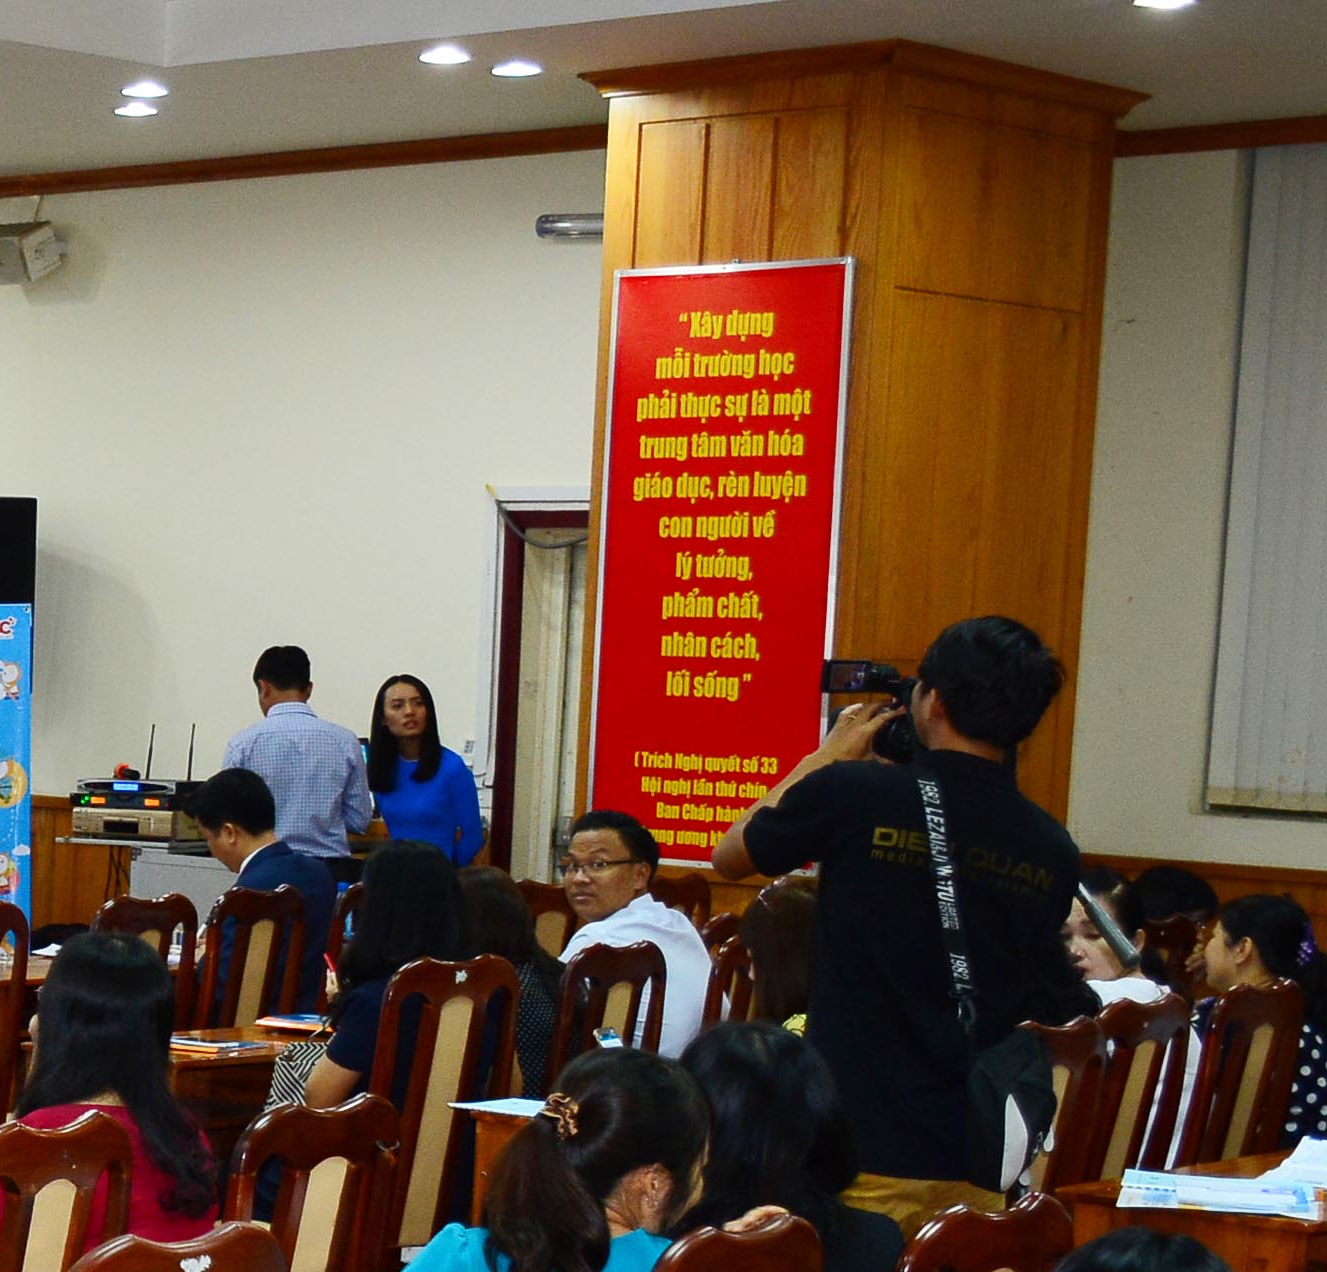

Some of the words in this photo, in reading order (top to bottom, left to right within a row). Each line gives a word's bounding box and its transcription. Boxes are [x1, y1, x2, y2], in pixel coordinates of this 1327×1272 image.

[726, 310, 774, 341] dựng
[656, 347, 690, 380] mỗi
[693, 350, 755, 379] trường
[758, 349, 794, 381] học
[637, 389, 677, 422] phải
[680, 391, 721, 423] thực
[725, 391, 748, 423] sự
[751, 389, 768, 416] là
[773, 389, 811, 421] một
[639, 435, 688, 461] trung
[691, 432, 726, 458] tâm
[730, 430, 764, 457] văn
[768, 429, 803, 456] hóa
[633, 472, 673, 501] giáo
[676, 473, 714, 504] dục,
[718, 472, 751, 497] rèn
[754, 471, 807, 503] luyện
[659, 516, 692, 538] con
[696, 512, 749, 541] người
[753, 510, 775, 538] về
[676, 551, 693, 579] lý
[696, 549, 753, 580] tưởng,
[662, 588, 713, 621] phẩm
[716, 591, 763, 622] chất,
[661, 632, 707, 659] nhân
[709, 634, 760, 661] cách,
[666, 669, 692, 697] lối
[675, 753, 703, 774] Nghị
[705, 755, 740, 774] quyết
[743, 755, 760, 773] số
[761, 757, 778, 774] 33
[641, 776, 661, 797] Hội
[664, 779, 691, 799] nghị
[693, 778, 713, 796] lần
[716, 780, 737, 798] thứ
[656, 801, 680, 819] Ban
[682, 802, 714, 822] Chấp
[676, 829, 708, 848] ương
